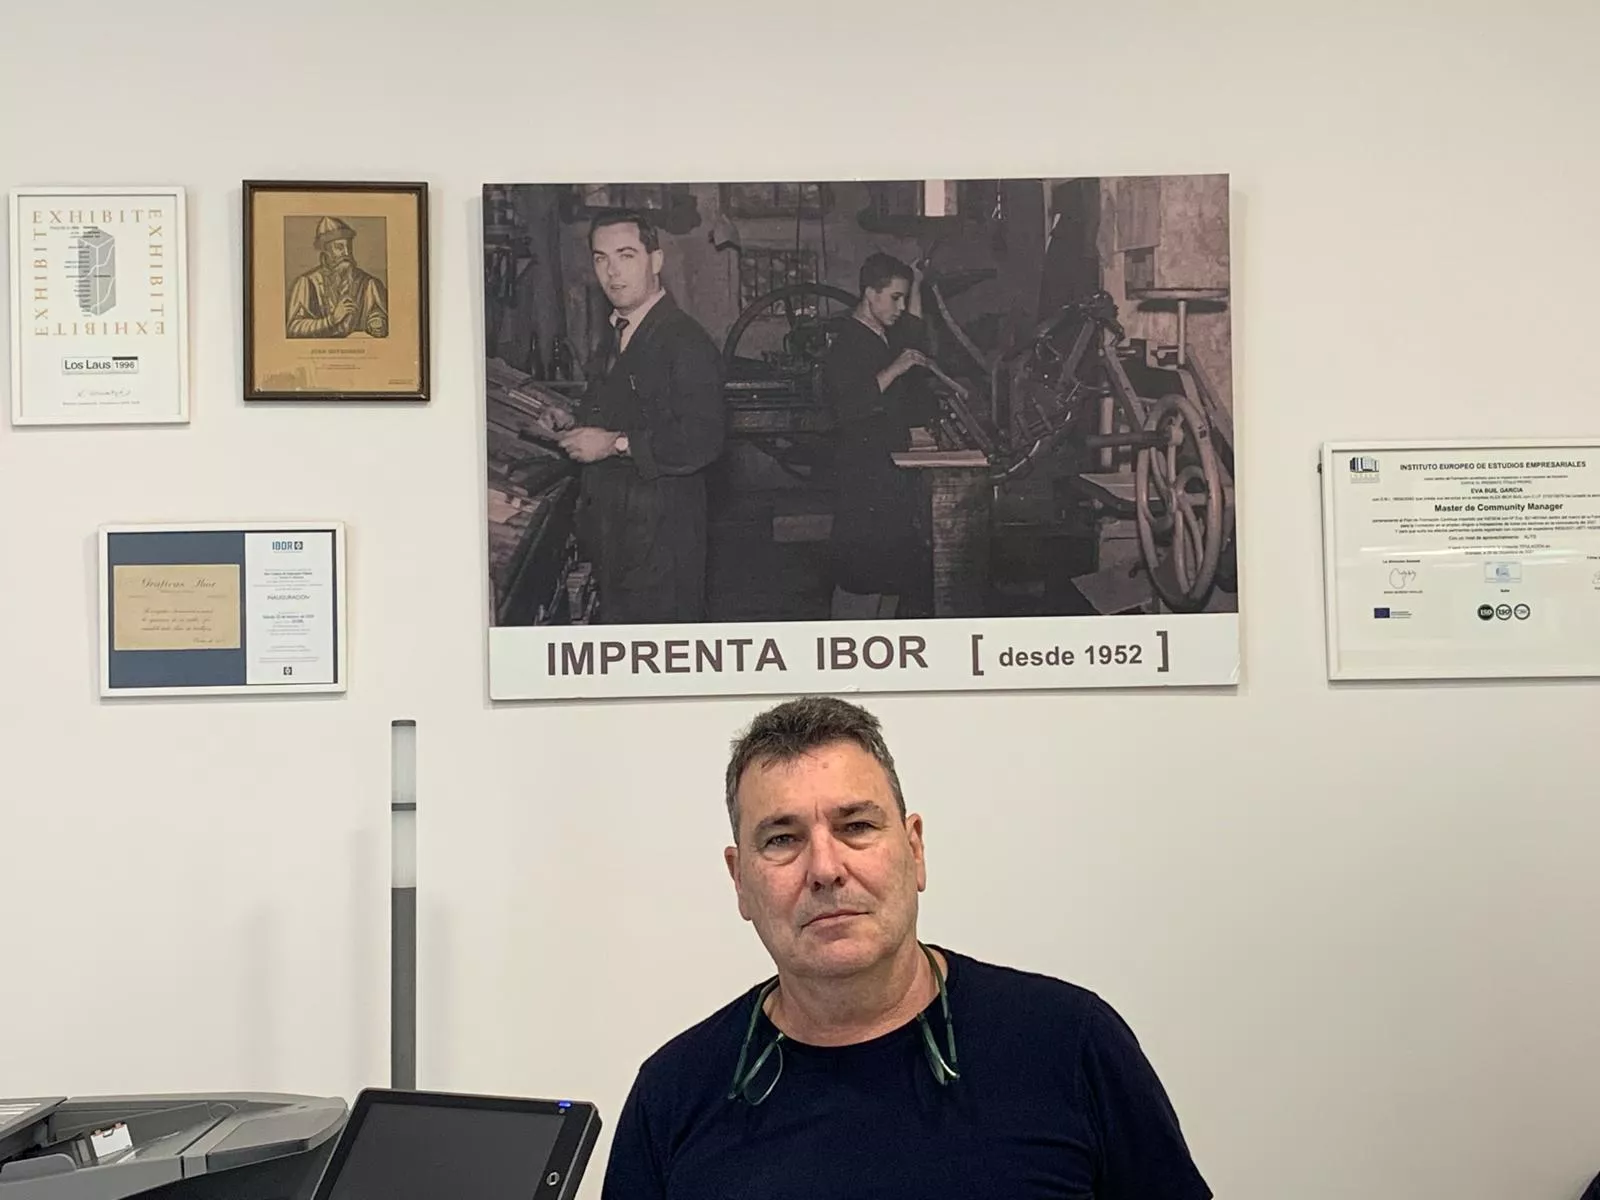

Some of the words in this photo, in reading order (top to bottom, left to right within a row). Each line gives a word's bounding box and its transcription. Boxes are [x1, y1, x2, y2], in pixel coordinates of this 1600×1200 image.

[32, 209, 145, 224] EXHIBIT
[148, 208, 165, 317] EXHIBIT
[32, 228, 49, 337] EXHIBIT
[52, 321, 165, 336] EXHIBIT
[64, 359, 84, 370] Los
[85, 359, 112, 370] Laus
[114, 361, 135, 369] 1996
[1399, 463, 1438, 471] INSTITUTO
[1439, 462, 1475, 470] EUROPEO
[1488, 461, 1524, 469] ESTUDIOS
[1525, 460, 1587, 468] EMPRESARIALES
[1434, 503, 1463, 512] Master
[1464, 503, 1476, 512] de
[1477, 502, 1526, 512] Community
[1527, 501, 1564, 511] Manager
[547, 637, 788, 676] IMPRENTA
[816, 635, 929, 671] IBOR
[998, 646, 1075, 667] desde
[1084, 644, 1143, 665] 1952
